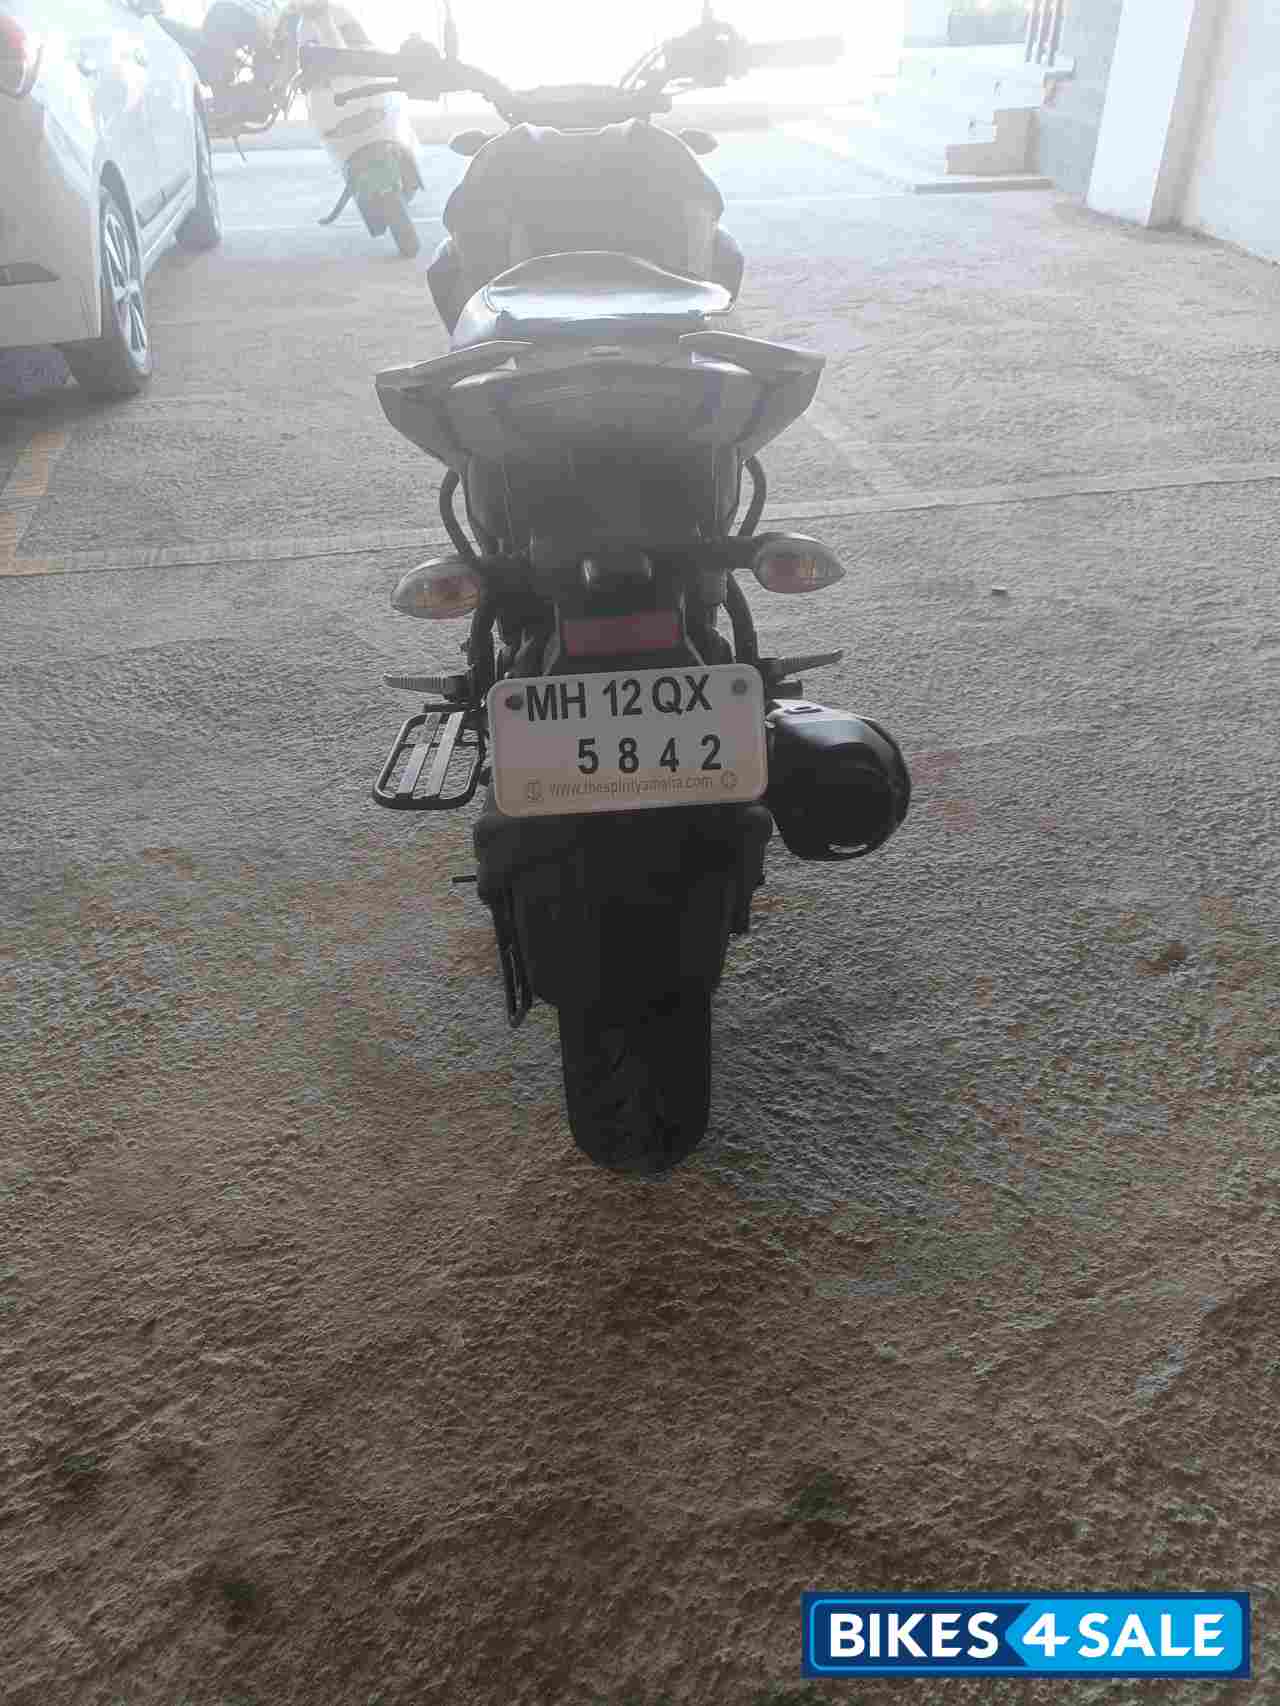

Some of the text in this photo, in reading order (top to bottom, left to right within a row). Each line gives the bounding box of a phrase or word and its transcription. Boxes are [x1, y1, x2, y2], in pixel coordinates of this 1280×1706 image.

[526, 674, 713, 722] MH 12 QX
